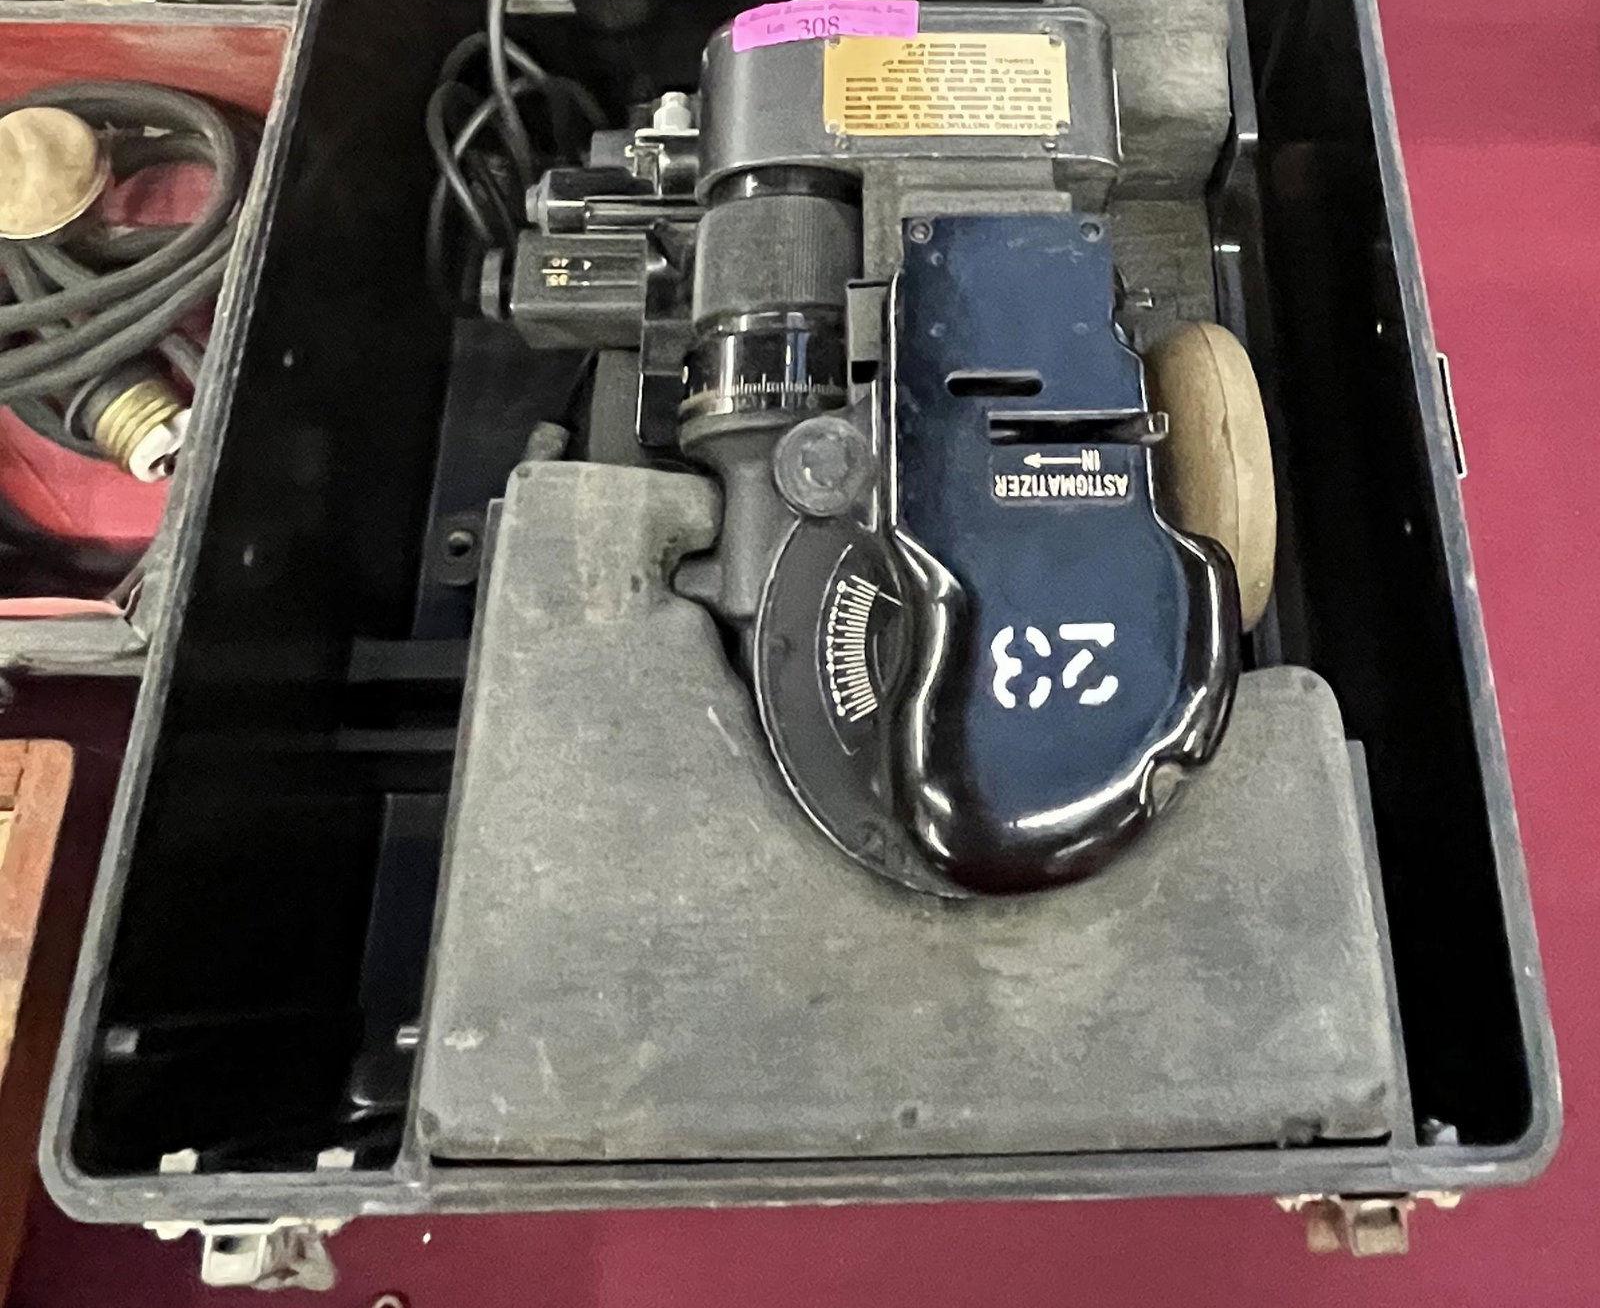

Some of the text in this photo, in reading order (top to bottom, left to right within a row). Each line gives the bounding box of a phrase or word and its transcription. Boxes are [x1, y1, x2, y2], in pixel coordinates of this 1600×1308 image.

[797, 15, 840, 38] 308
[1081, 449, 1100, 471] IN
[994, 474, 1129, 497] ASTIGMATIZER
[991, 622, 1119, 709] 23
